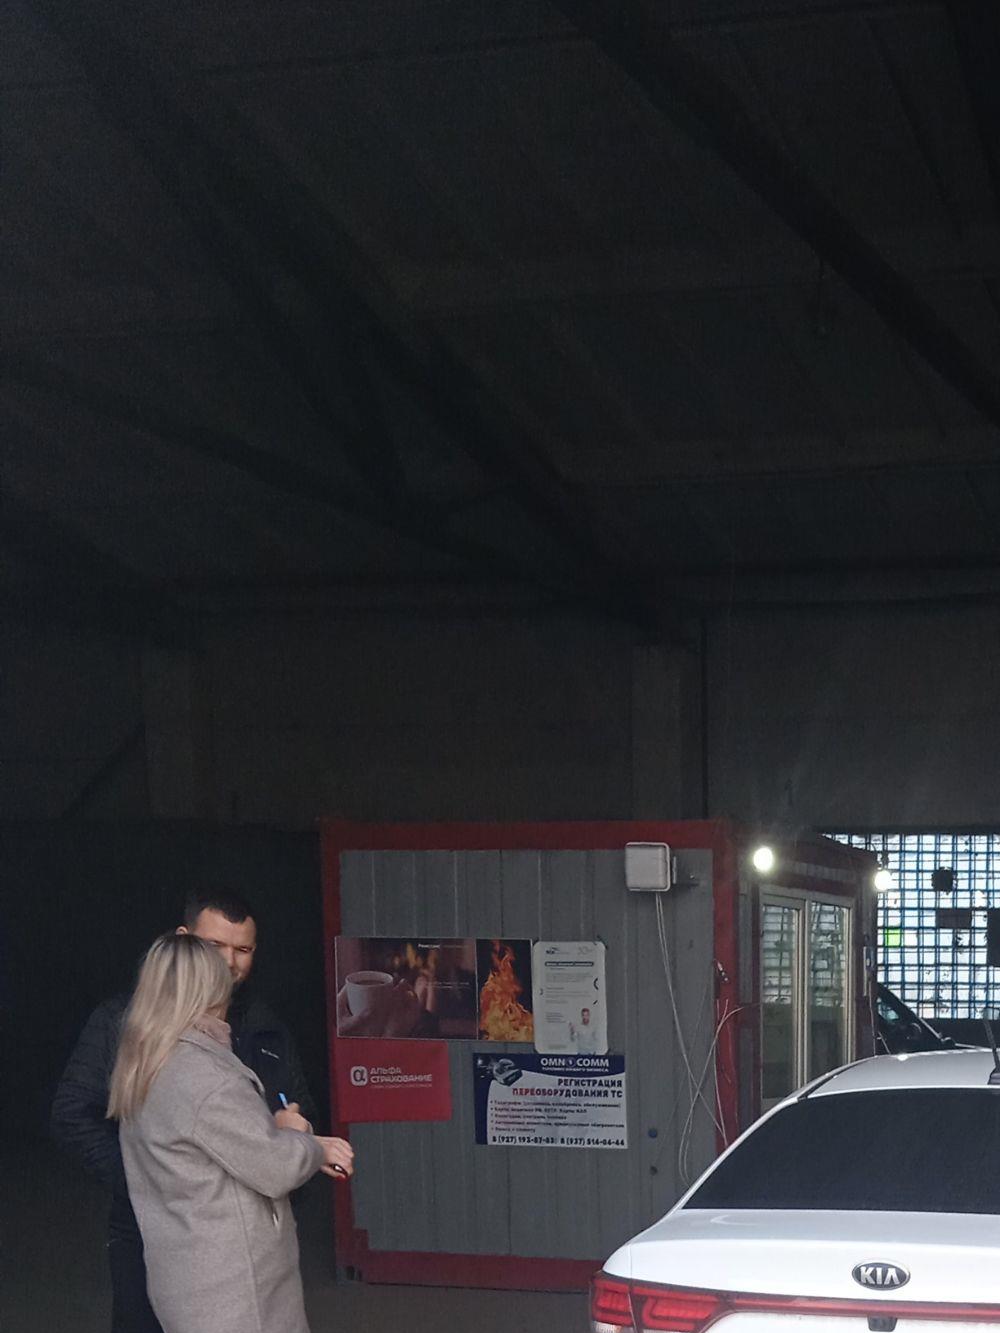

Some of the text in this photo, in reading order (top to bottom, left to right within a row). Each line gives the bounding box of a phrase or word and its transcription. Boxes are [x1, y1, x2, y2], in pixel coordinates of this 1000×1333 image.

[370, 1066, 402, 1074] АЛЬФА
[370, 1074, 433, 1083] СТРАХОВАНИЕ
[557, 1078, 623, 1088] РЕГИСТРАЦИЯ
[512, 1088, 623, 1098] ПЕРЕОБОРУДОВАНИЯ ТС
[860, 1267, 901, 1286] KIA
